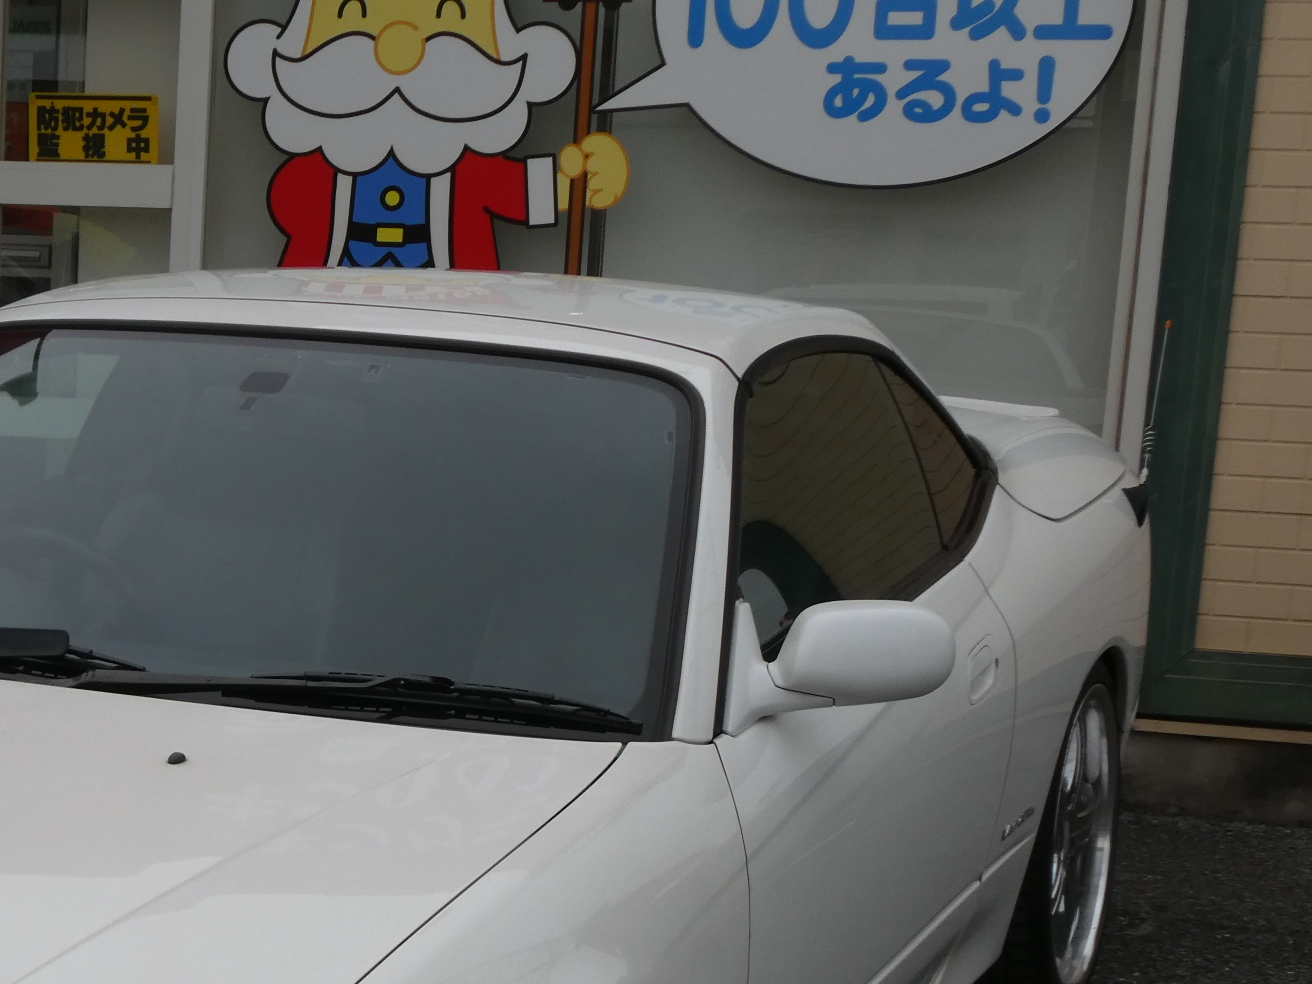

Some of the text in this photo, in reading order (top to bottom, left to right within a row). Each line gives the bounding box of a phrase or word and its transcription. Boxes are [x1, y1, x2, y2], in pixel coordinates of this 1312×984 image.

[822, 55, 1057, 125] あるよ!
[37, 106, 150, 133] 防犯カメラ
[37, 133, 150, 159] 監視中
